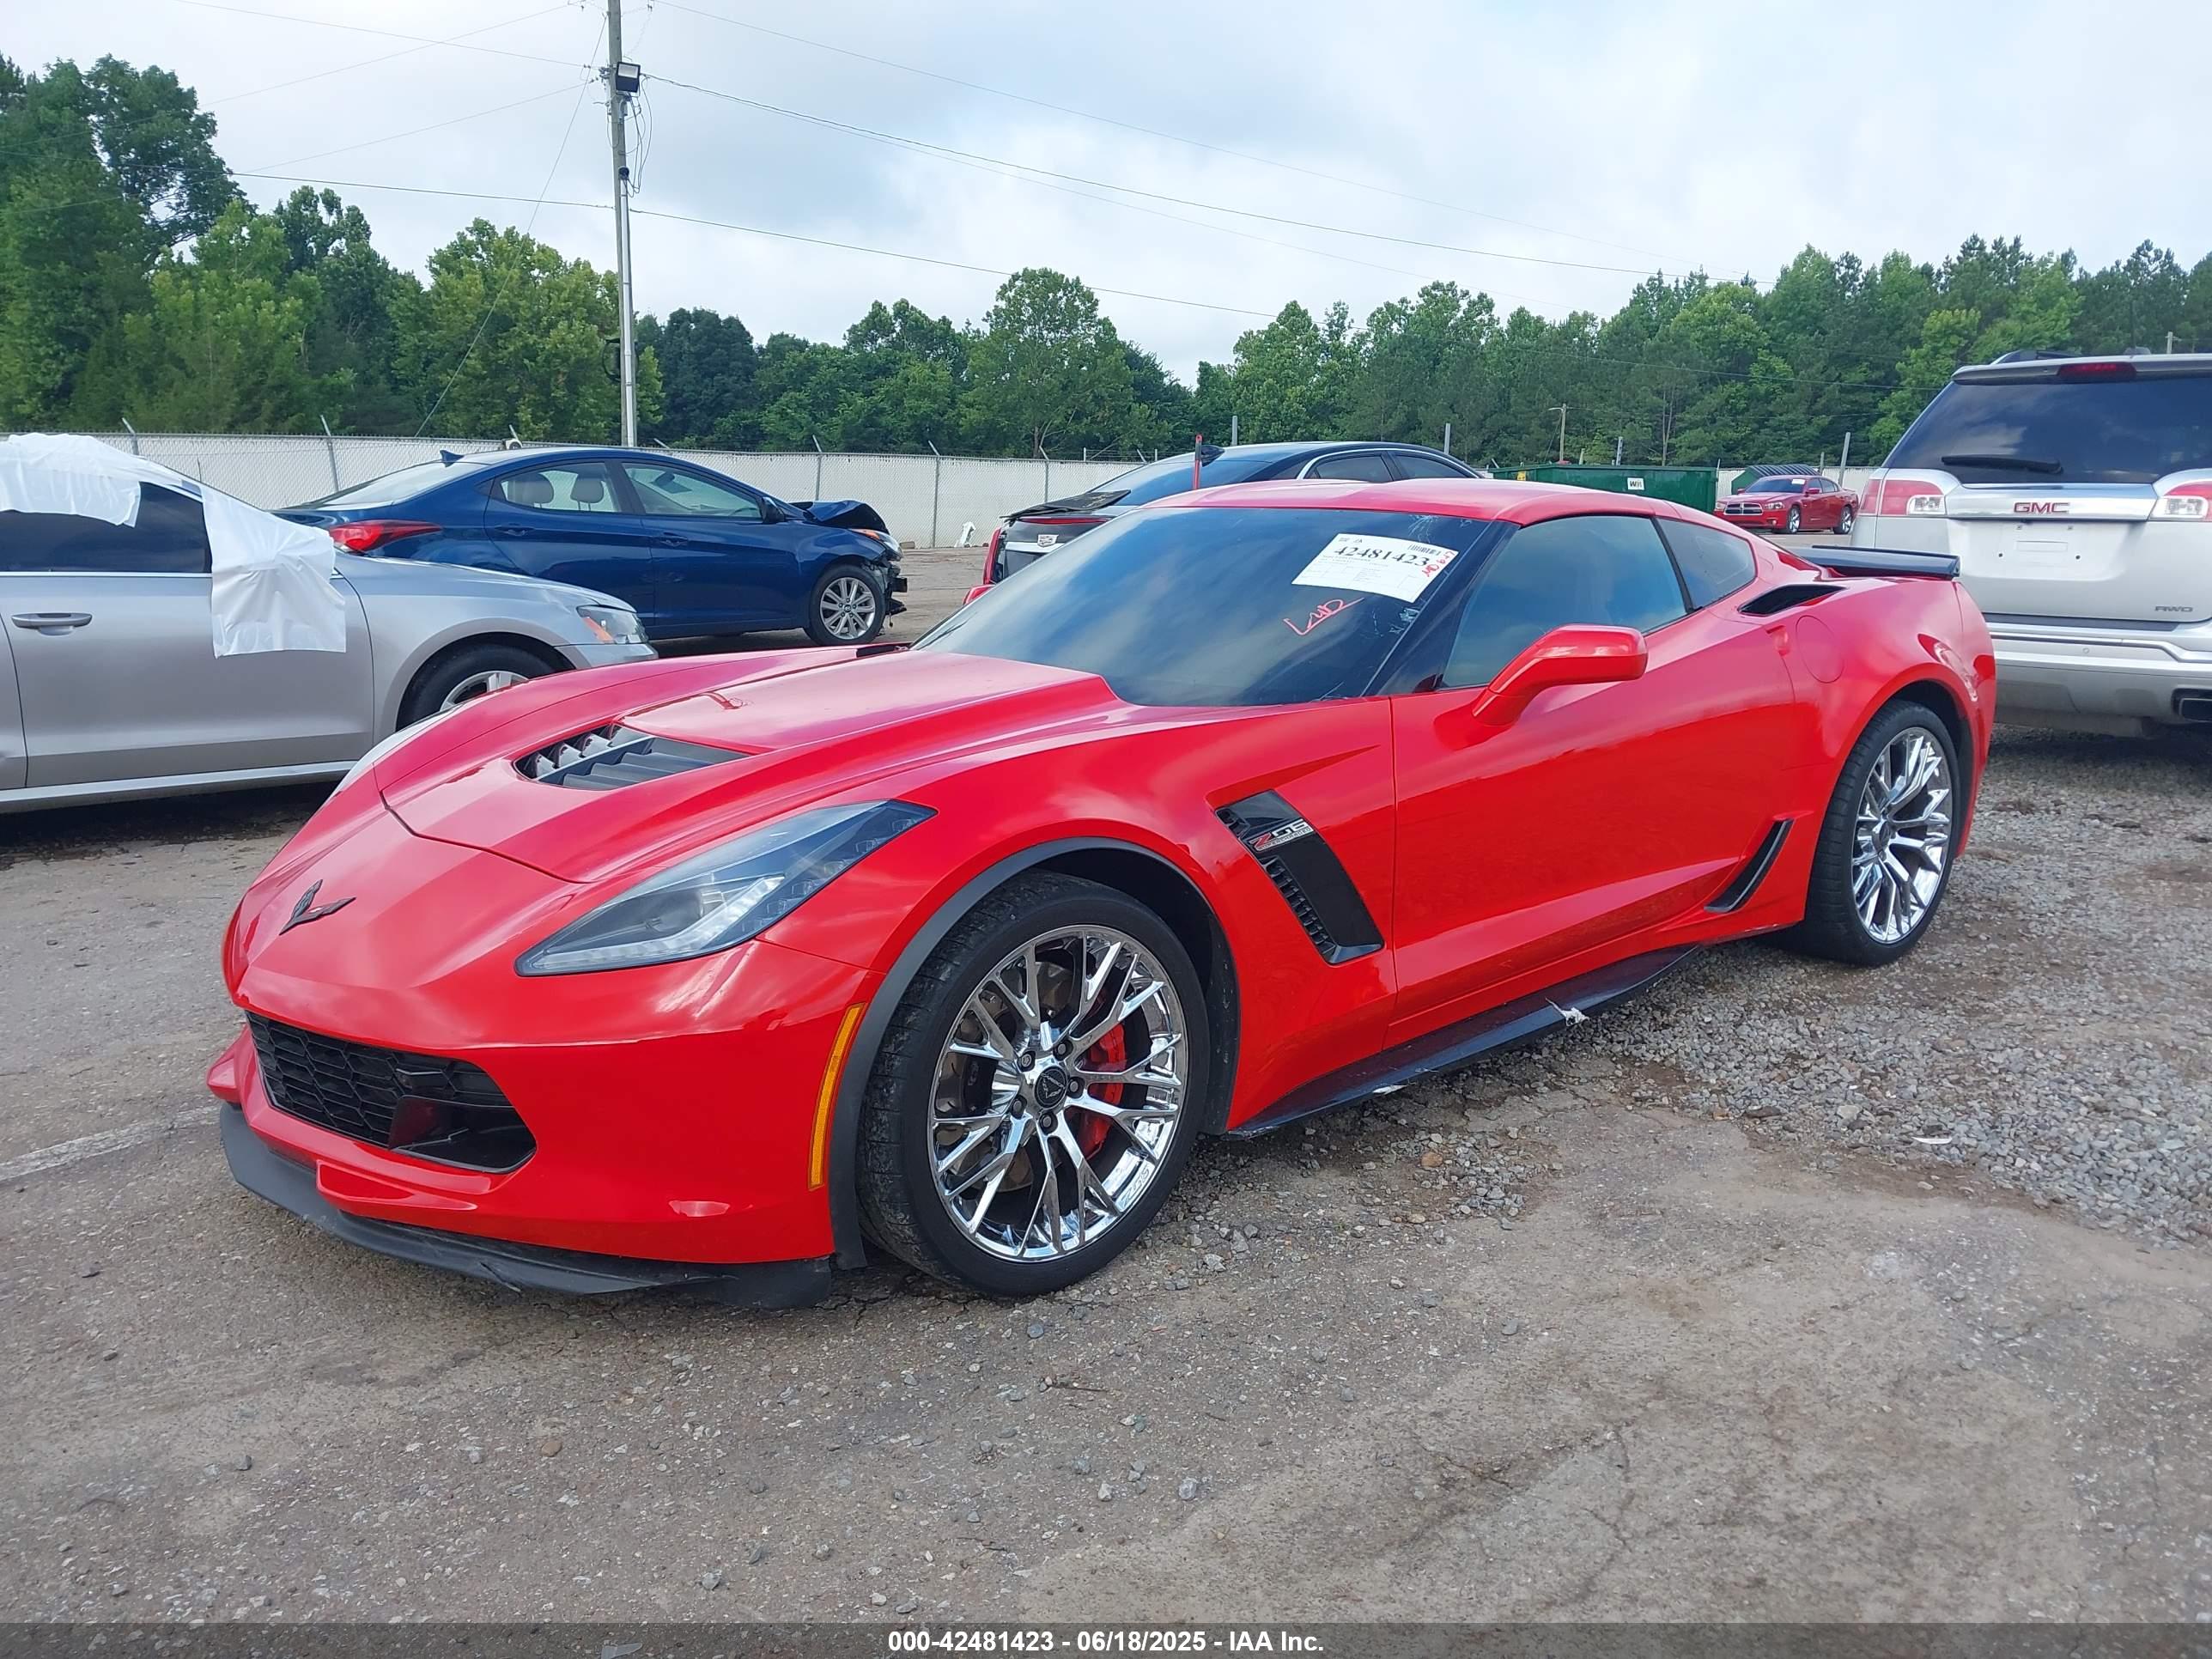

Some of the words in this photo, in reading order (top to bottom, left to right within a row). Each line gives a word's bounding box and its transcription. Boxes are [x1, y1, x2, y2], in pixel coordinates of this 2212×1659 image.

[2014, 501, 2070, 514] GMC
[1334, 546, 1430, 567] 42481423
[1249, 818, 1312, 848] Z06
